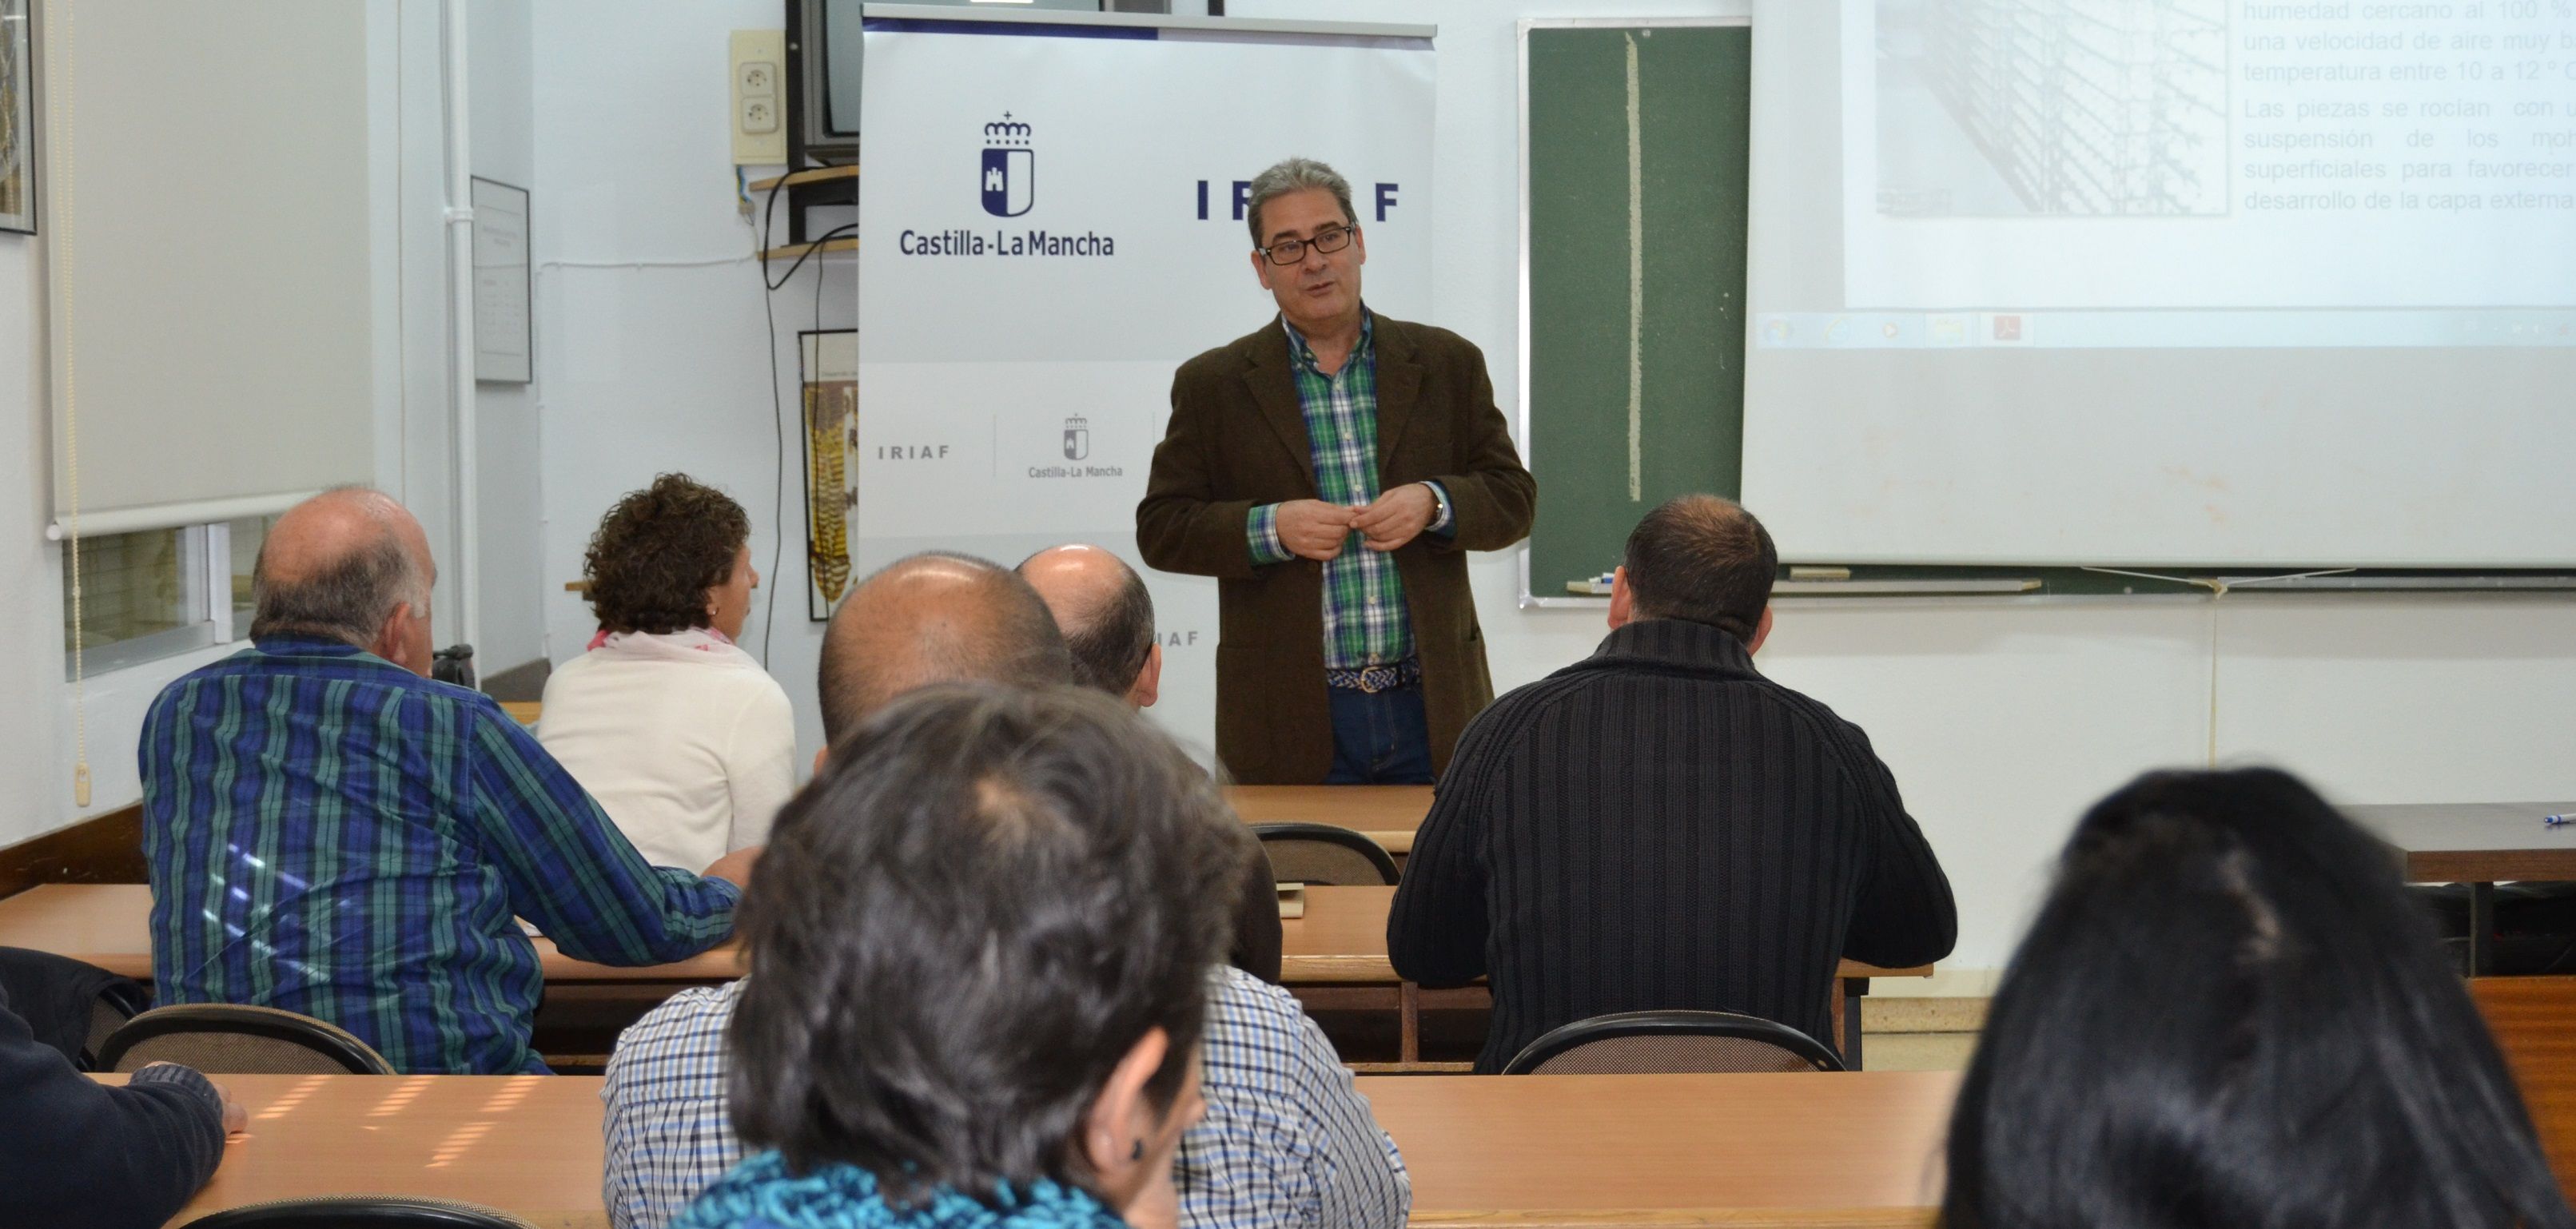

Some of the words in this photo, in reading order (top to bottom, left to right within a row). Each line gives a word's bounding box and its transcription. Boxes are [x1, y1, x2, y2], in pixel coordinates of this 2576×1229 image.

[2244, 1, 2349, 20] humedad
[2363, 4, 2452, 20] cercano
[2466, 1, 2483, 19] al
[2500, 0, 2538, 19] 100
[2244, 35, 2285, 50] una
[2296, 31, 2403, 50] velocidad
[2414, 31, 2443, 50] de
[2451, 31, 2493, 50] aire
[2503, 34, 2550, 54] muy
[2244, 63, 2380, 85] temperatura
[2390, 63, 2447, 81] entre
[2458, 61, 2482, 81] 10
[2491, 66, 2504, 81] a
[2514, 61, 2539, 80] 12
[2244, 99, 2284, 117] Las
[2297, 99, 2369, 121] piezas
[2383, 102, 2407, 117] se
[2514, 101, 2554, 117] con
[2244, 129, 2373, 152] suspensión
[2407, 129, 2434, 148] de
[2468, 129, 2498, 148] los
[2244, 160, 2386, 183] superficiales
[2403, 163, 2451, 182] para
[2468, 160, 2571, 178] favorecer
[2244, 192, 2356, 209] desarrollo
[2364, 192, 2391, 209] de
[2401, 192, 2419, 209] la
[2428, 194, 2481, 213] capa
[1029, 231, 1114, 257] Mancha
[878, 445, 950, 459] IRIAF
[1086, 466, 1123, 477] Mancha
[1157, 631, 1198, 646] IAF
